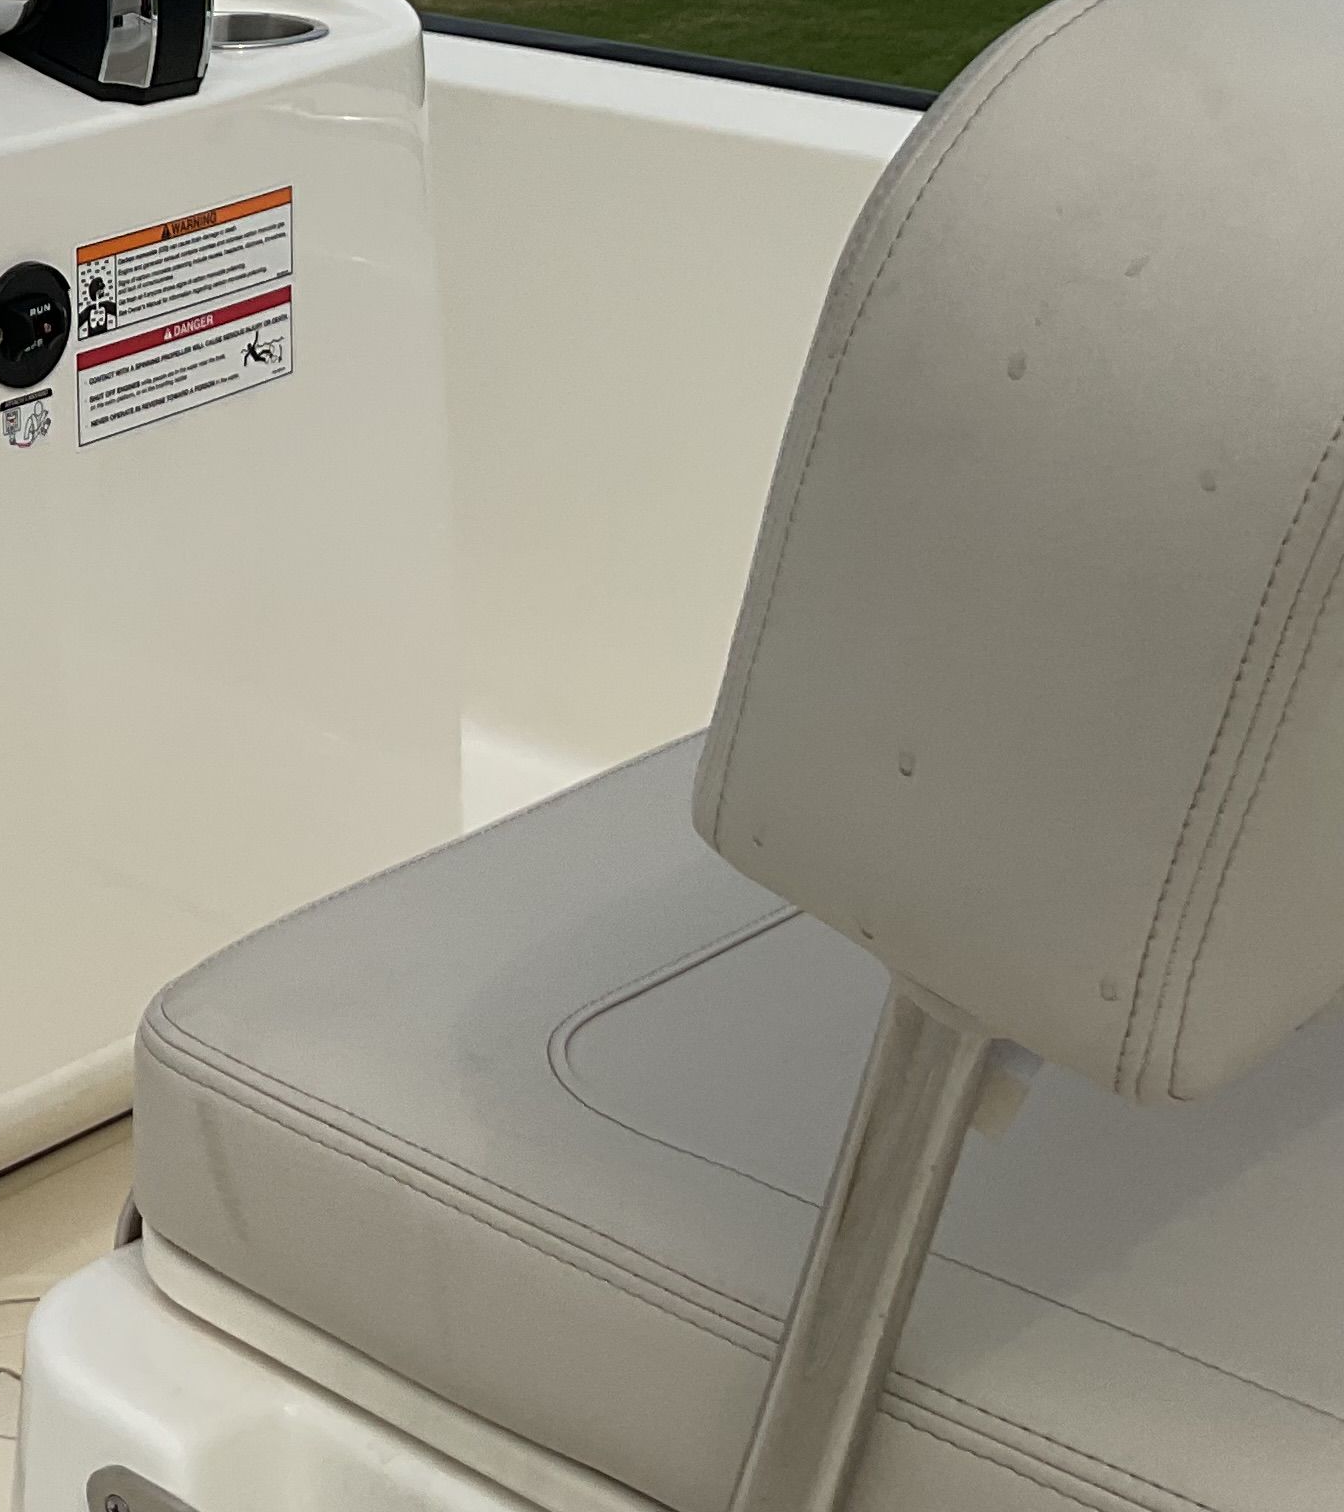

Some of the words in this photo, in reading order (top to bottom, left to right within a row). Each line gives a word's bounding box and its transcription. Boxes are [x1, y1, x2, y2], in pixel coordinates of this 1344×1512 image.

[171, 213, 217, 235] WARNING
[29, 303, 51, 317] RUN
[174, 314, 213, 337] DANGER
